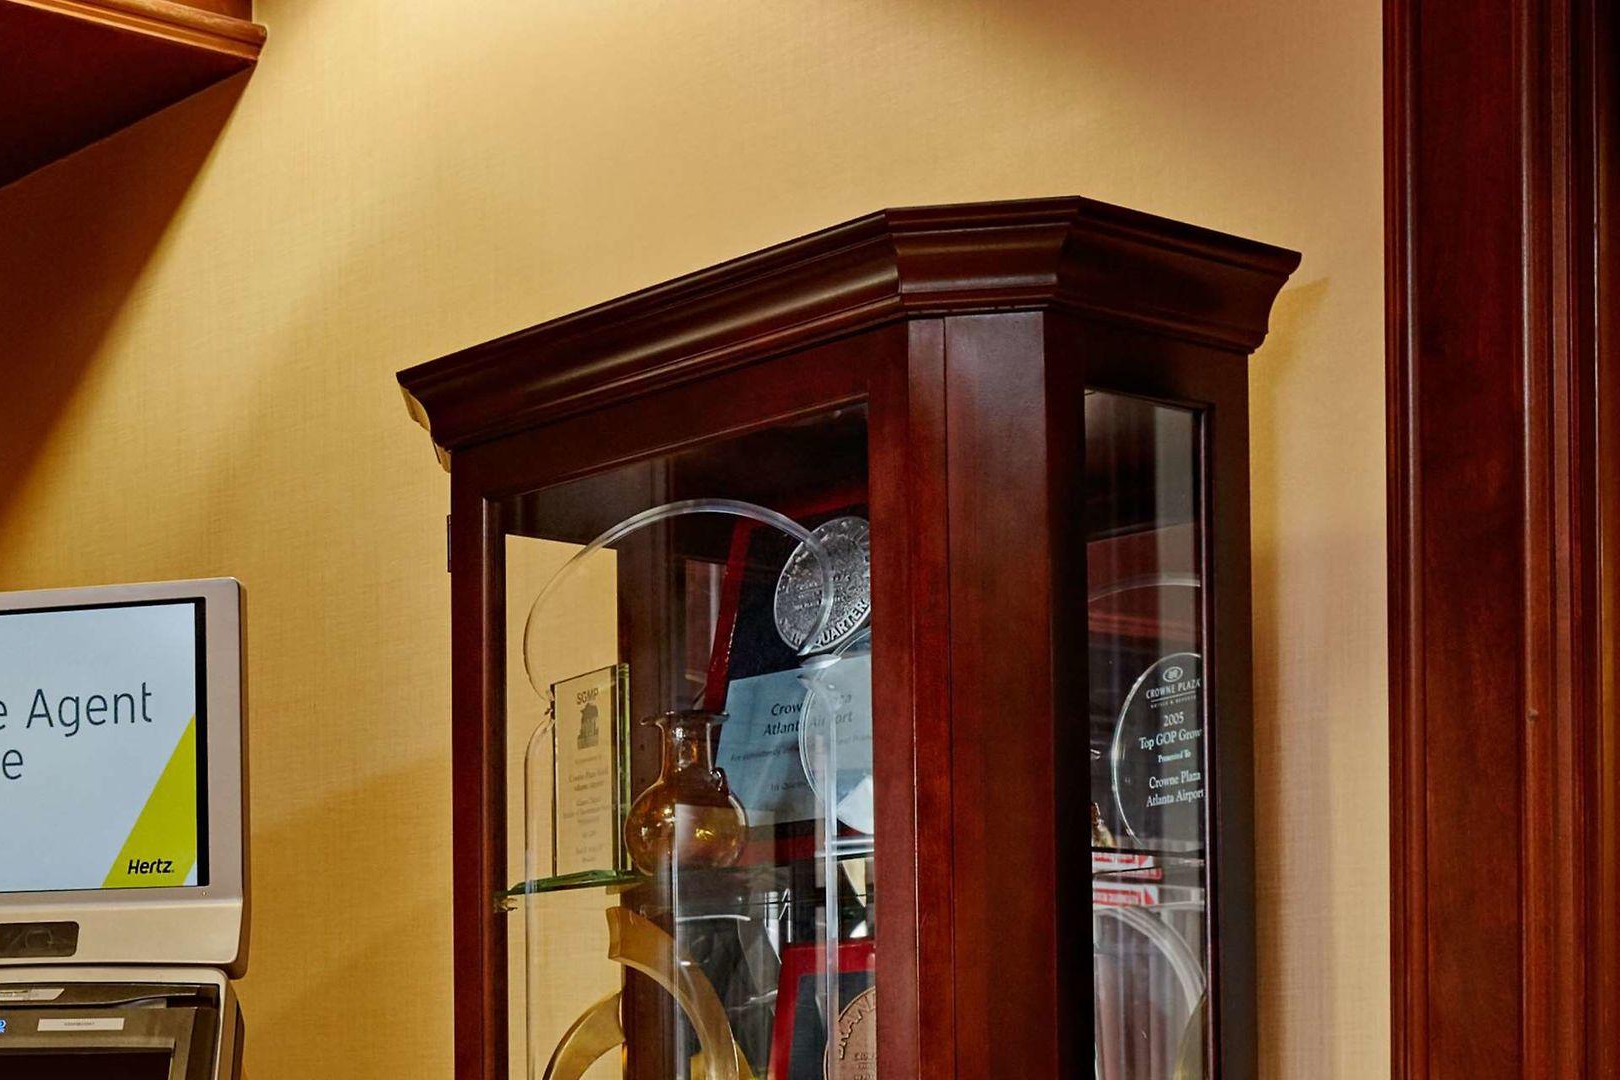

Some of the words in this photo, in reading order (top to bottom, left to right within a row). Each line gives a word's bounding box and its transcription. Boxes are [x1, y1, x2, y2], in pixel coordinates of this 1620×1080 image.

[1146, 686, 1175, 699] CROWNE
[1178, 679, 1201, 692] PLAZA
[26, 682, 153, 738] Agent
[771, 701, 803, 717] Crow
[764, 722, 801, 737] Atlant
[809, 711, 853, 728] Airort
[1163, 711, 1184, 727] 2005
[1139, 736, 1155, 750] Top
[1156, 731, 1177, 746] GOP
[1149, 774, 1179, 789] Crowne
[1181, 769, 1202, 784] Plaza
[1146, 793, 1175, 807] Atlanta
[1176, 788, 1204, 803] Airport
[127, 858, 173, 876] Hertz
